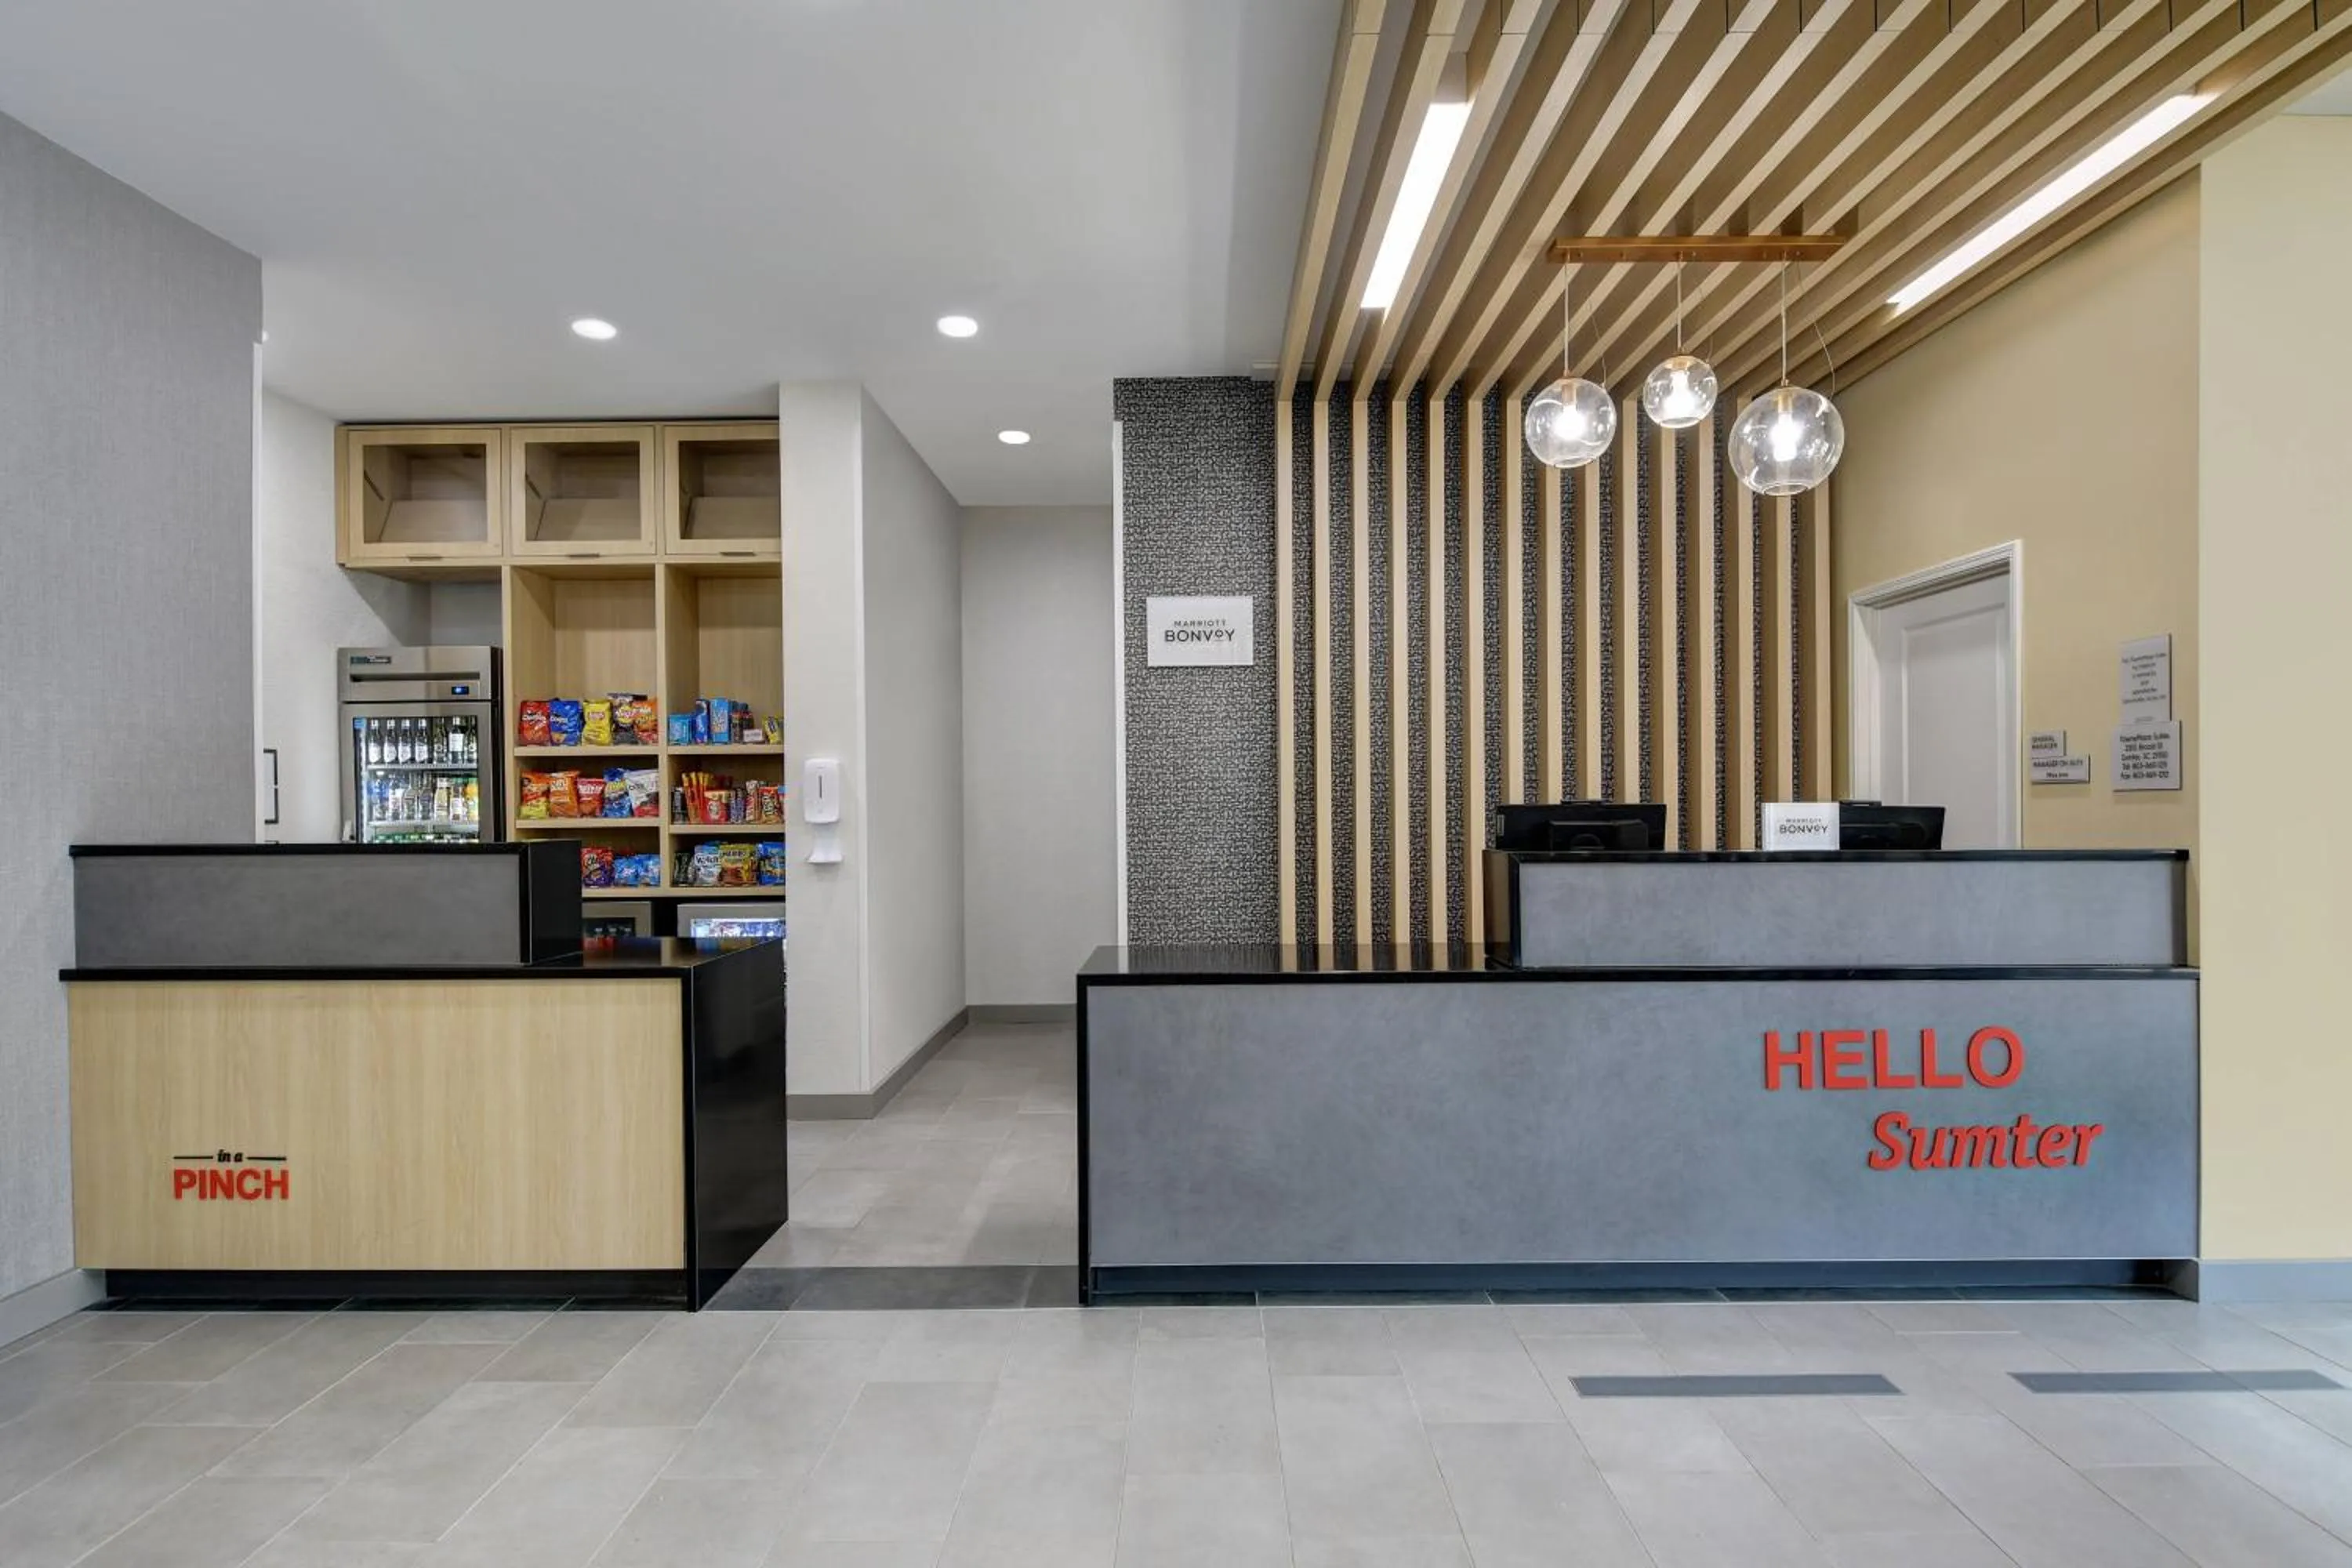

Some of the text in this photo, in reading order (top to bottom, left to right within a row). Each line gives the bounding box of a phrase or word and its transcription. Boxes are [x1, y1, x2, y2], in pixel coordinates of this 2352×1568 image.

[1165, 630, 1235, 642] BONVOY
[1779, 824, 1828, 834] BONVOY
[1764, 1025, 2025, 1091] HELLO
[1868, 1110, 2105, 1171] Sumter
[217, 1149, 243, 1163] in a
[173, 1168, 289, 1200] PINCH
